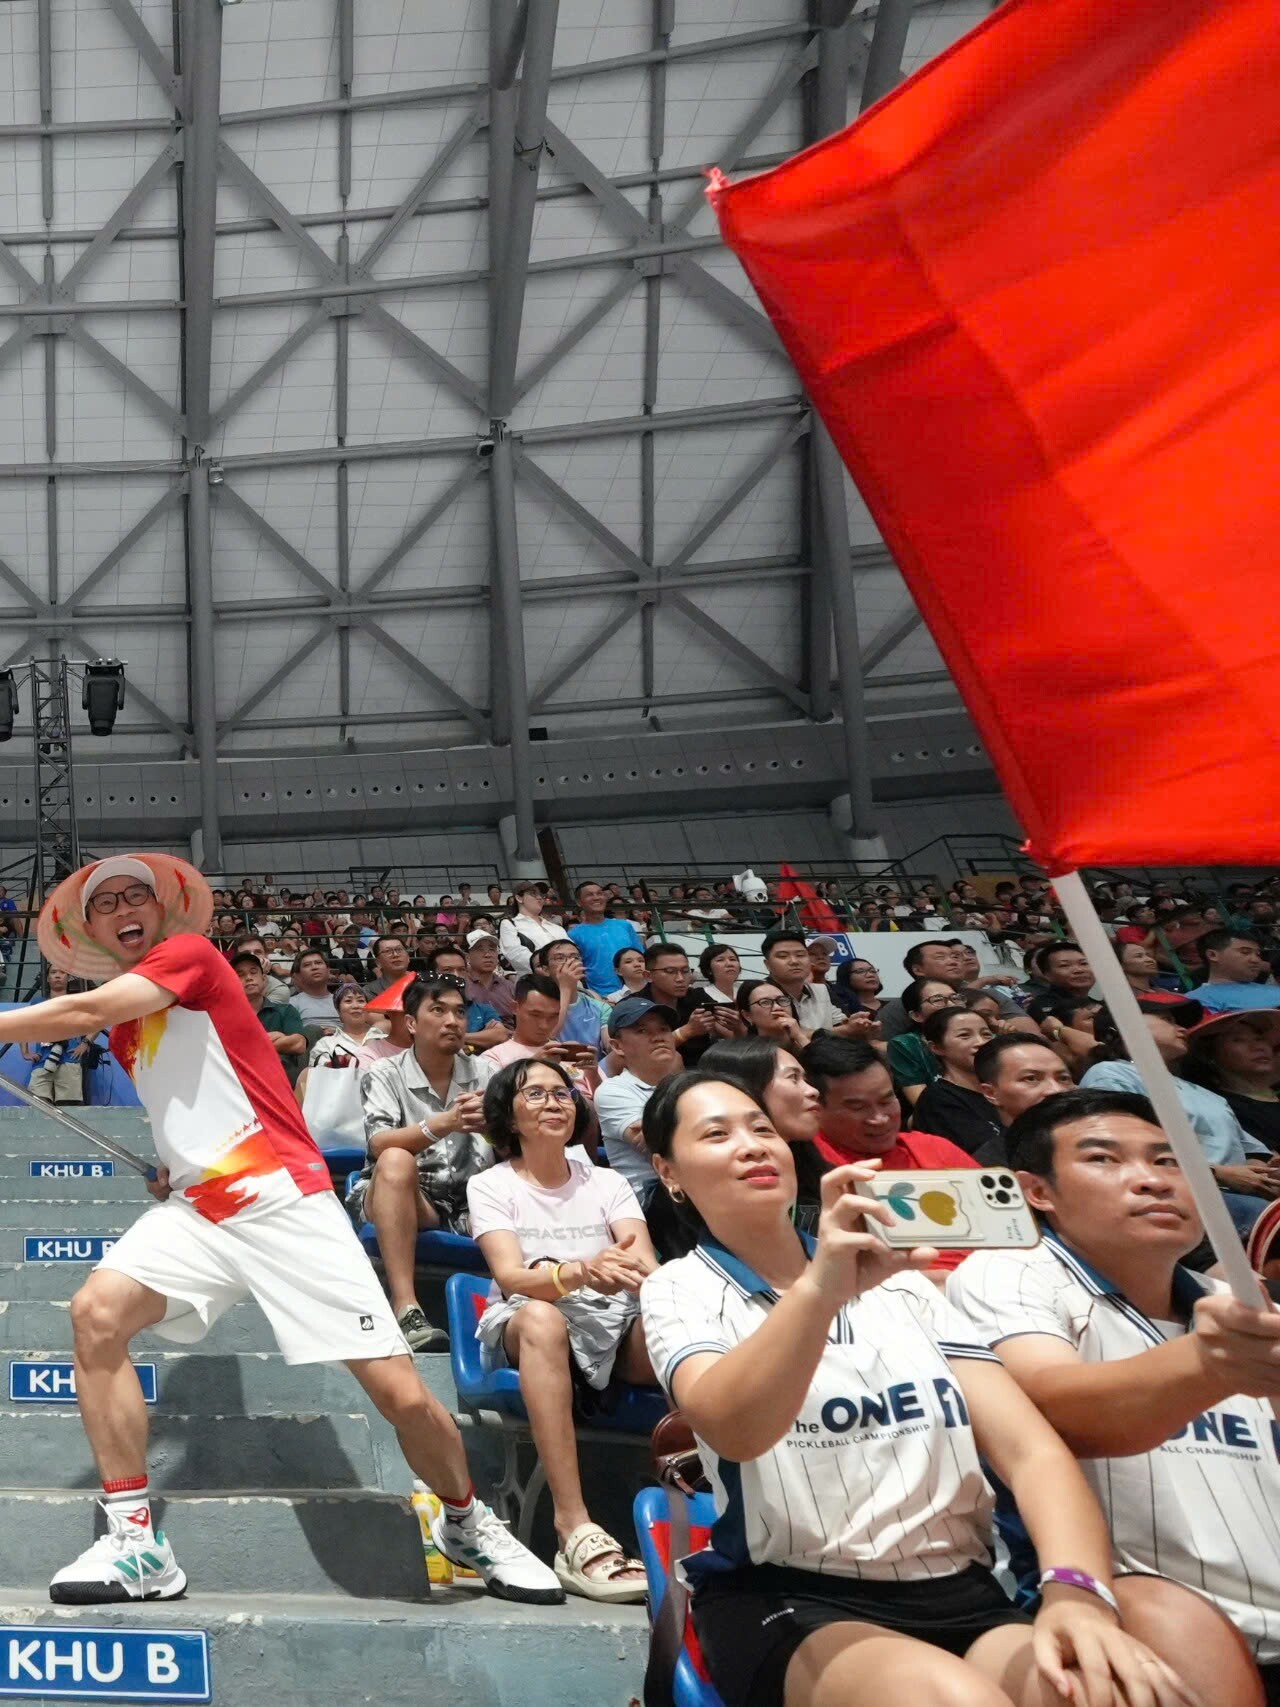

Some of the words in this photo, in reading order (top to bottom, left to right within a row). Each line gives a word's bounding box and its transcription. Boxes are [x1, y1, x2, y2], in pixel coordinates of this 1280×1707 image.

[41, 1165, 83, 1177] KHU
[91, 1165, 104, 1177] B
[515, 1224, 607, 1240] PRACTICE
[38, 1241, 91, 1257] KHU
[29, 1369, 77, 1394] KH
[796, 1420, 819, 1433] he
[821, 1382, 925, 1433] ONE
[787, 1438, 850, 1449] PICKLEBALL
[853, 1424, 931, 1444] CHAMPIONSHIP
[1167, 1411, 1258, 1449] NE
[9, 1639, 123, 1683] KHU
[147, 1643, 180, 1684] B
